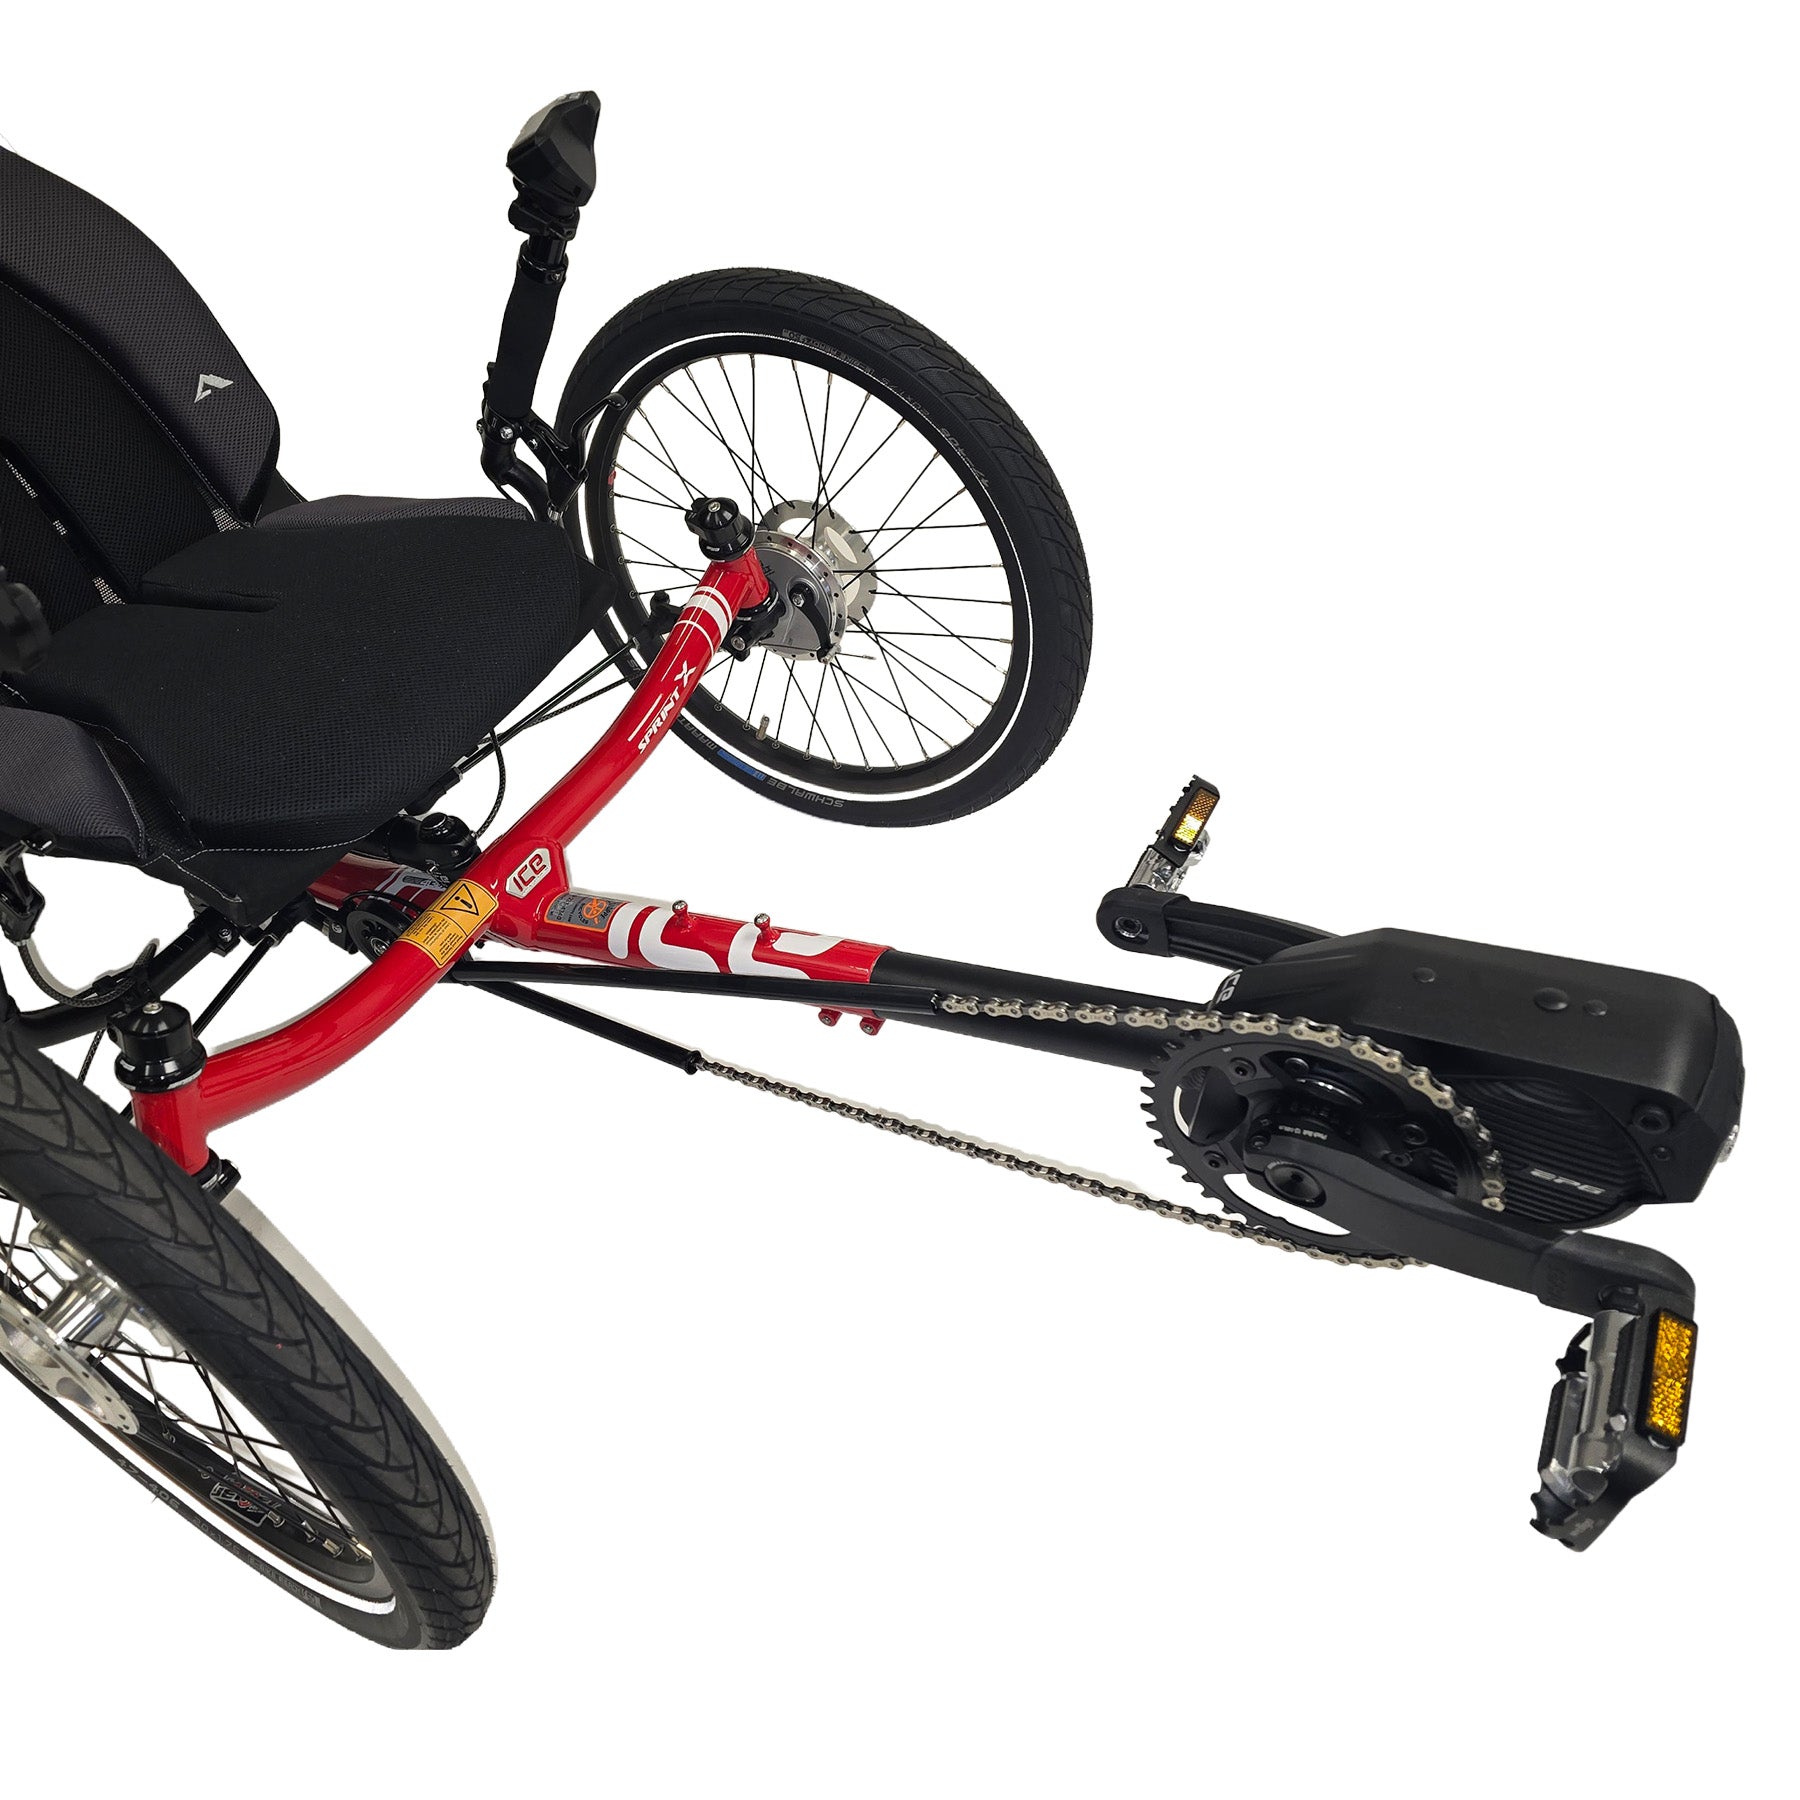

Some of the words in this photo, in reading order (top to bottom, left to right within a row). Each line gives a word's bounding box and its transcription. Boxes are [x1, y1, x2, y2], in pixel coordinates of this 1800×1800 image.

[638, 686, 681, 754] SPRINT
[674, 660, 697, 688] X
[678, 716, 718, 751] MARAT
[767, 776, 845, 809] SCHWALBE
[512, 853, 547, 892] ICE
[116, 1457, 181, 1510] 47-406
